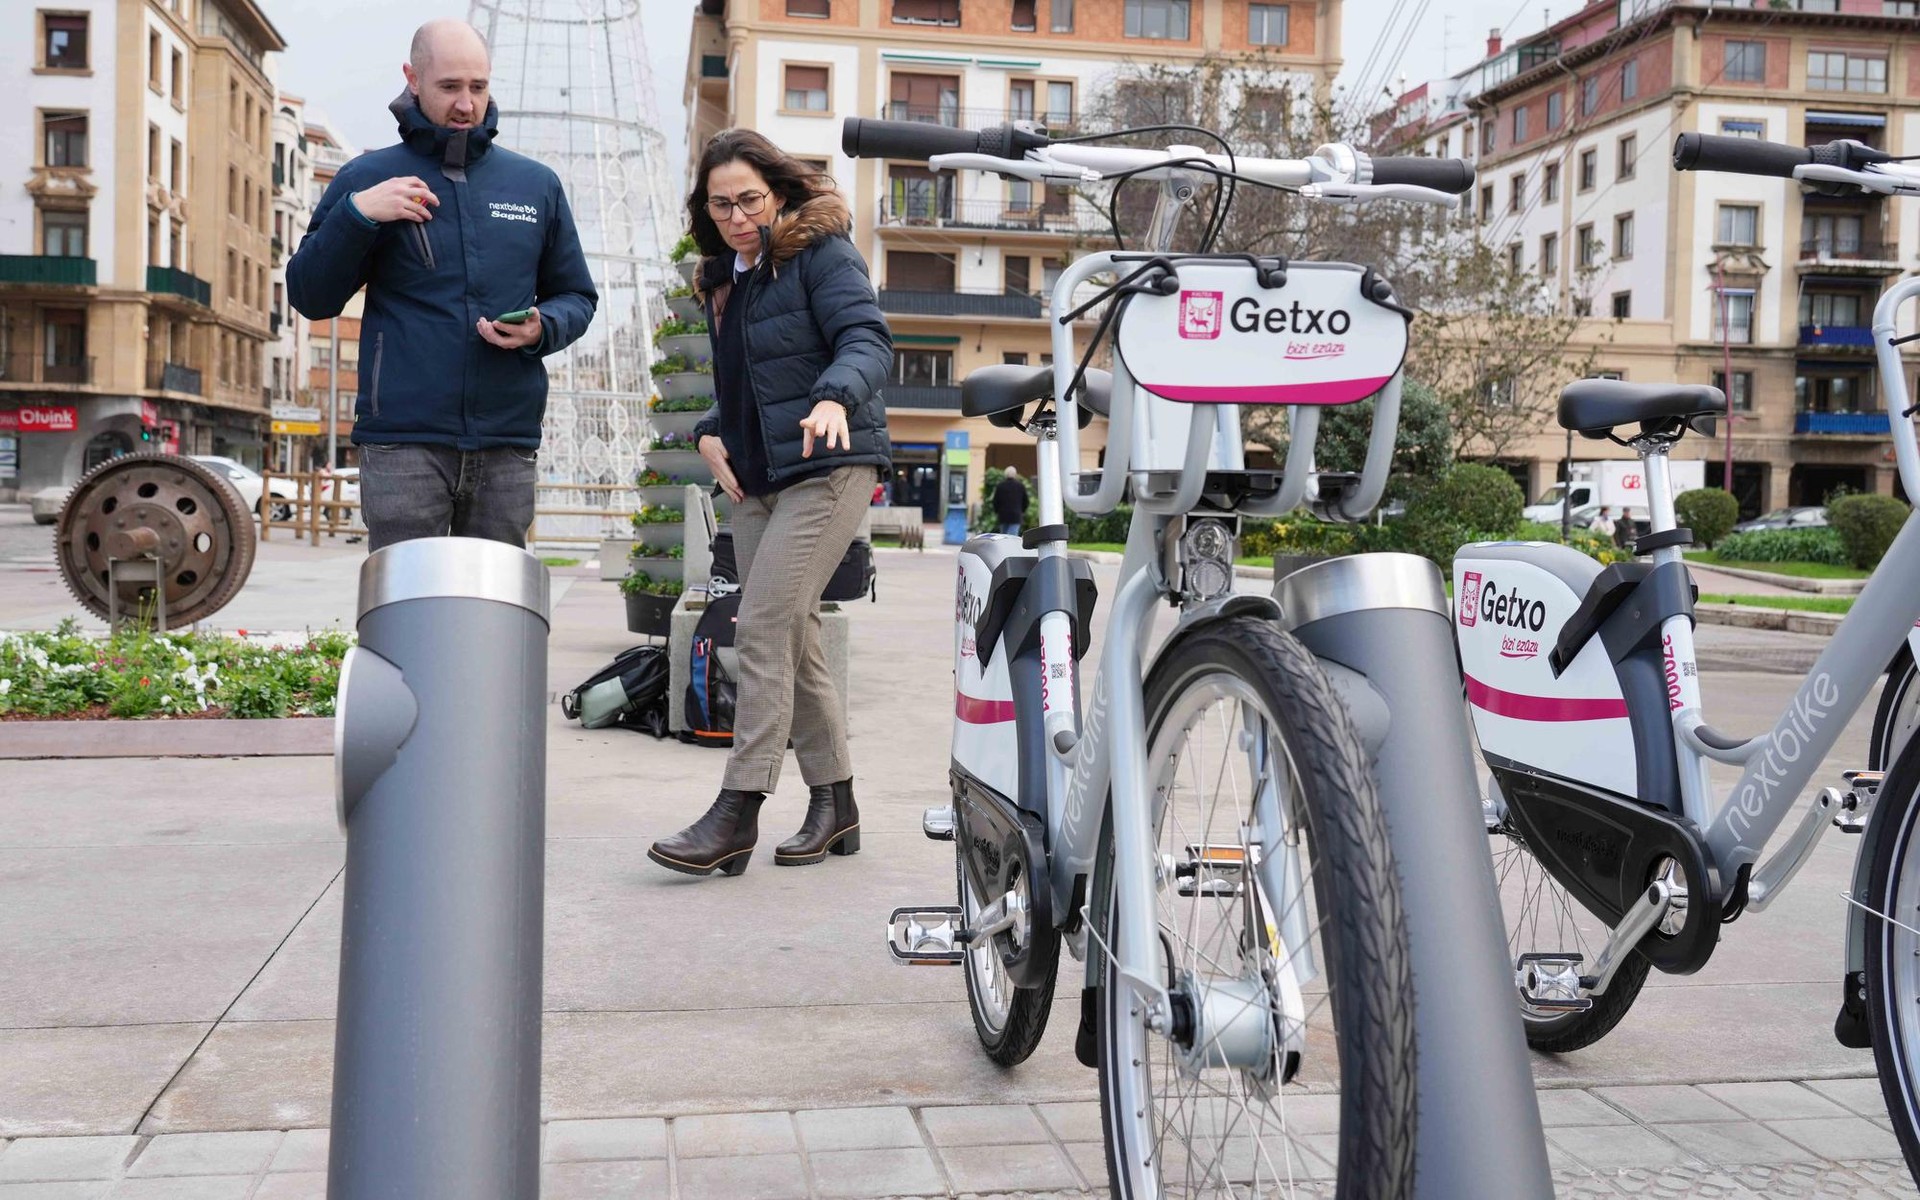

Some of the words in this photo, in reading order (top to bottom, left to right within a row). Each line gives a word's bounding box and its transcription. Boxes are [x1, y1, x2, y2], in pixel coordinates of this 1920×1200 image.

[489, 203, 525, 213] nextbike
[491, 210, 538, 223] Sagalés
[1230, 296, 1351, 336] Getxo
[1286, 341, 1310, 355] bizi
[1481, 580, 1546, 632] Getxo
[1663, 634, 1684, 711] 370004
[1725, 672, 1839, 842] nextbike
